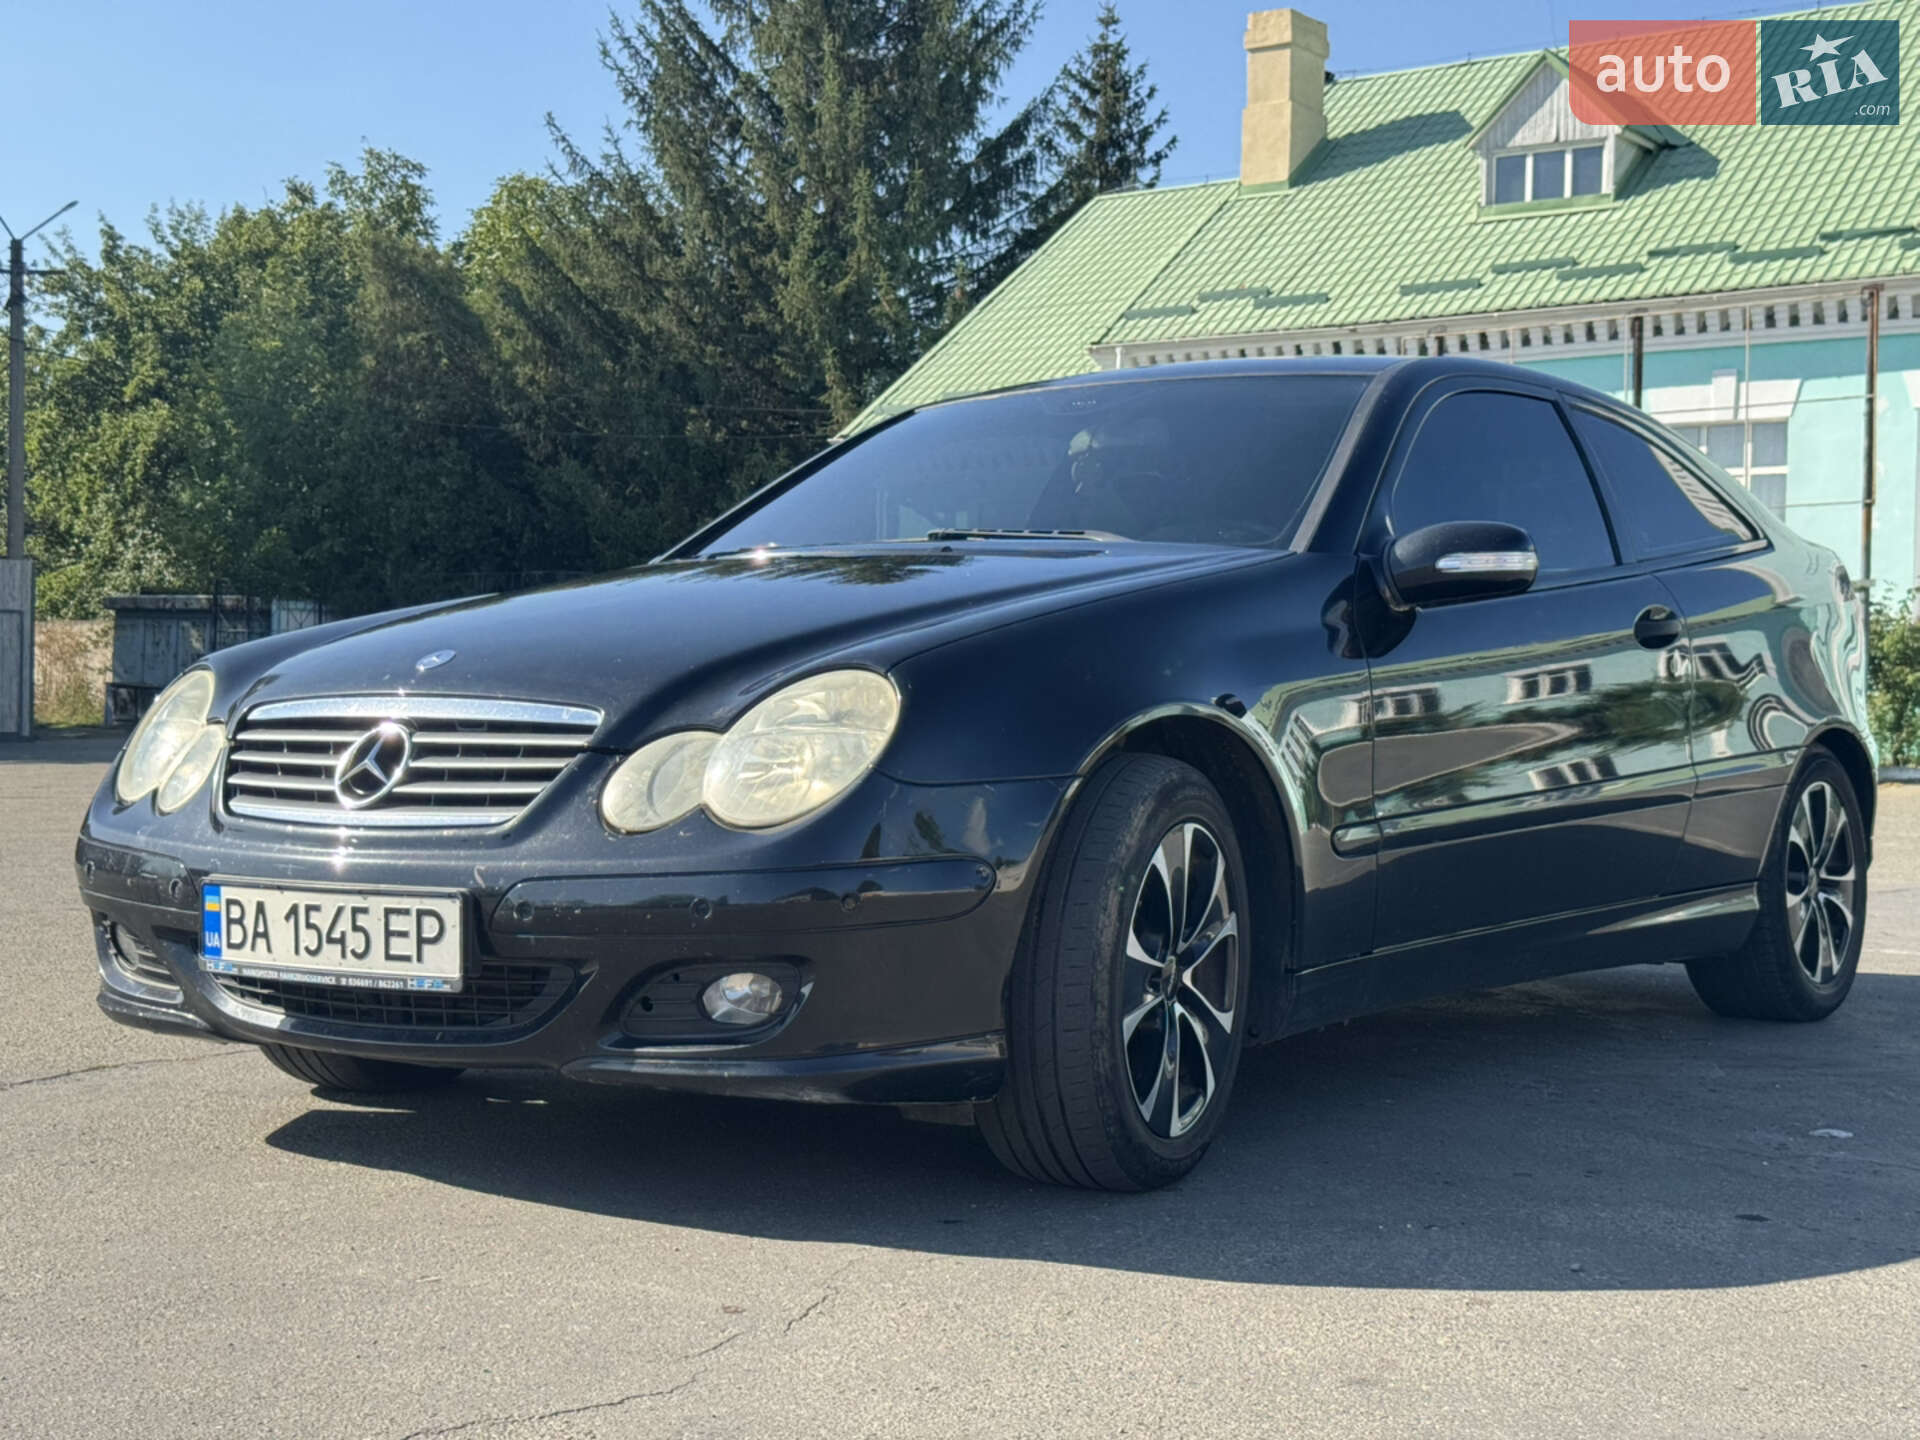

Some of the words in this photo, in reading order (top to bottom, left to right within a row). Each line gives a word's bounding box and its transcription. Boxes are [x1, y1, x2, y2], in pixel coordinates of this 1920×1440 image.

[205, 932, 221, 949] UA
[225, 898, 273, 954] BA
[283, 902, 371, 961] 1545
[383, 907, 446, 963] EP
